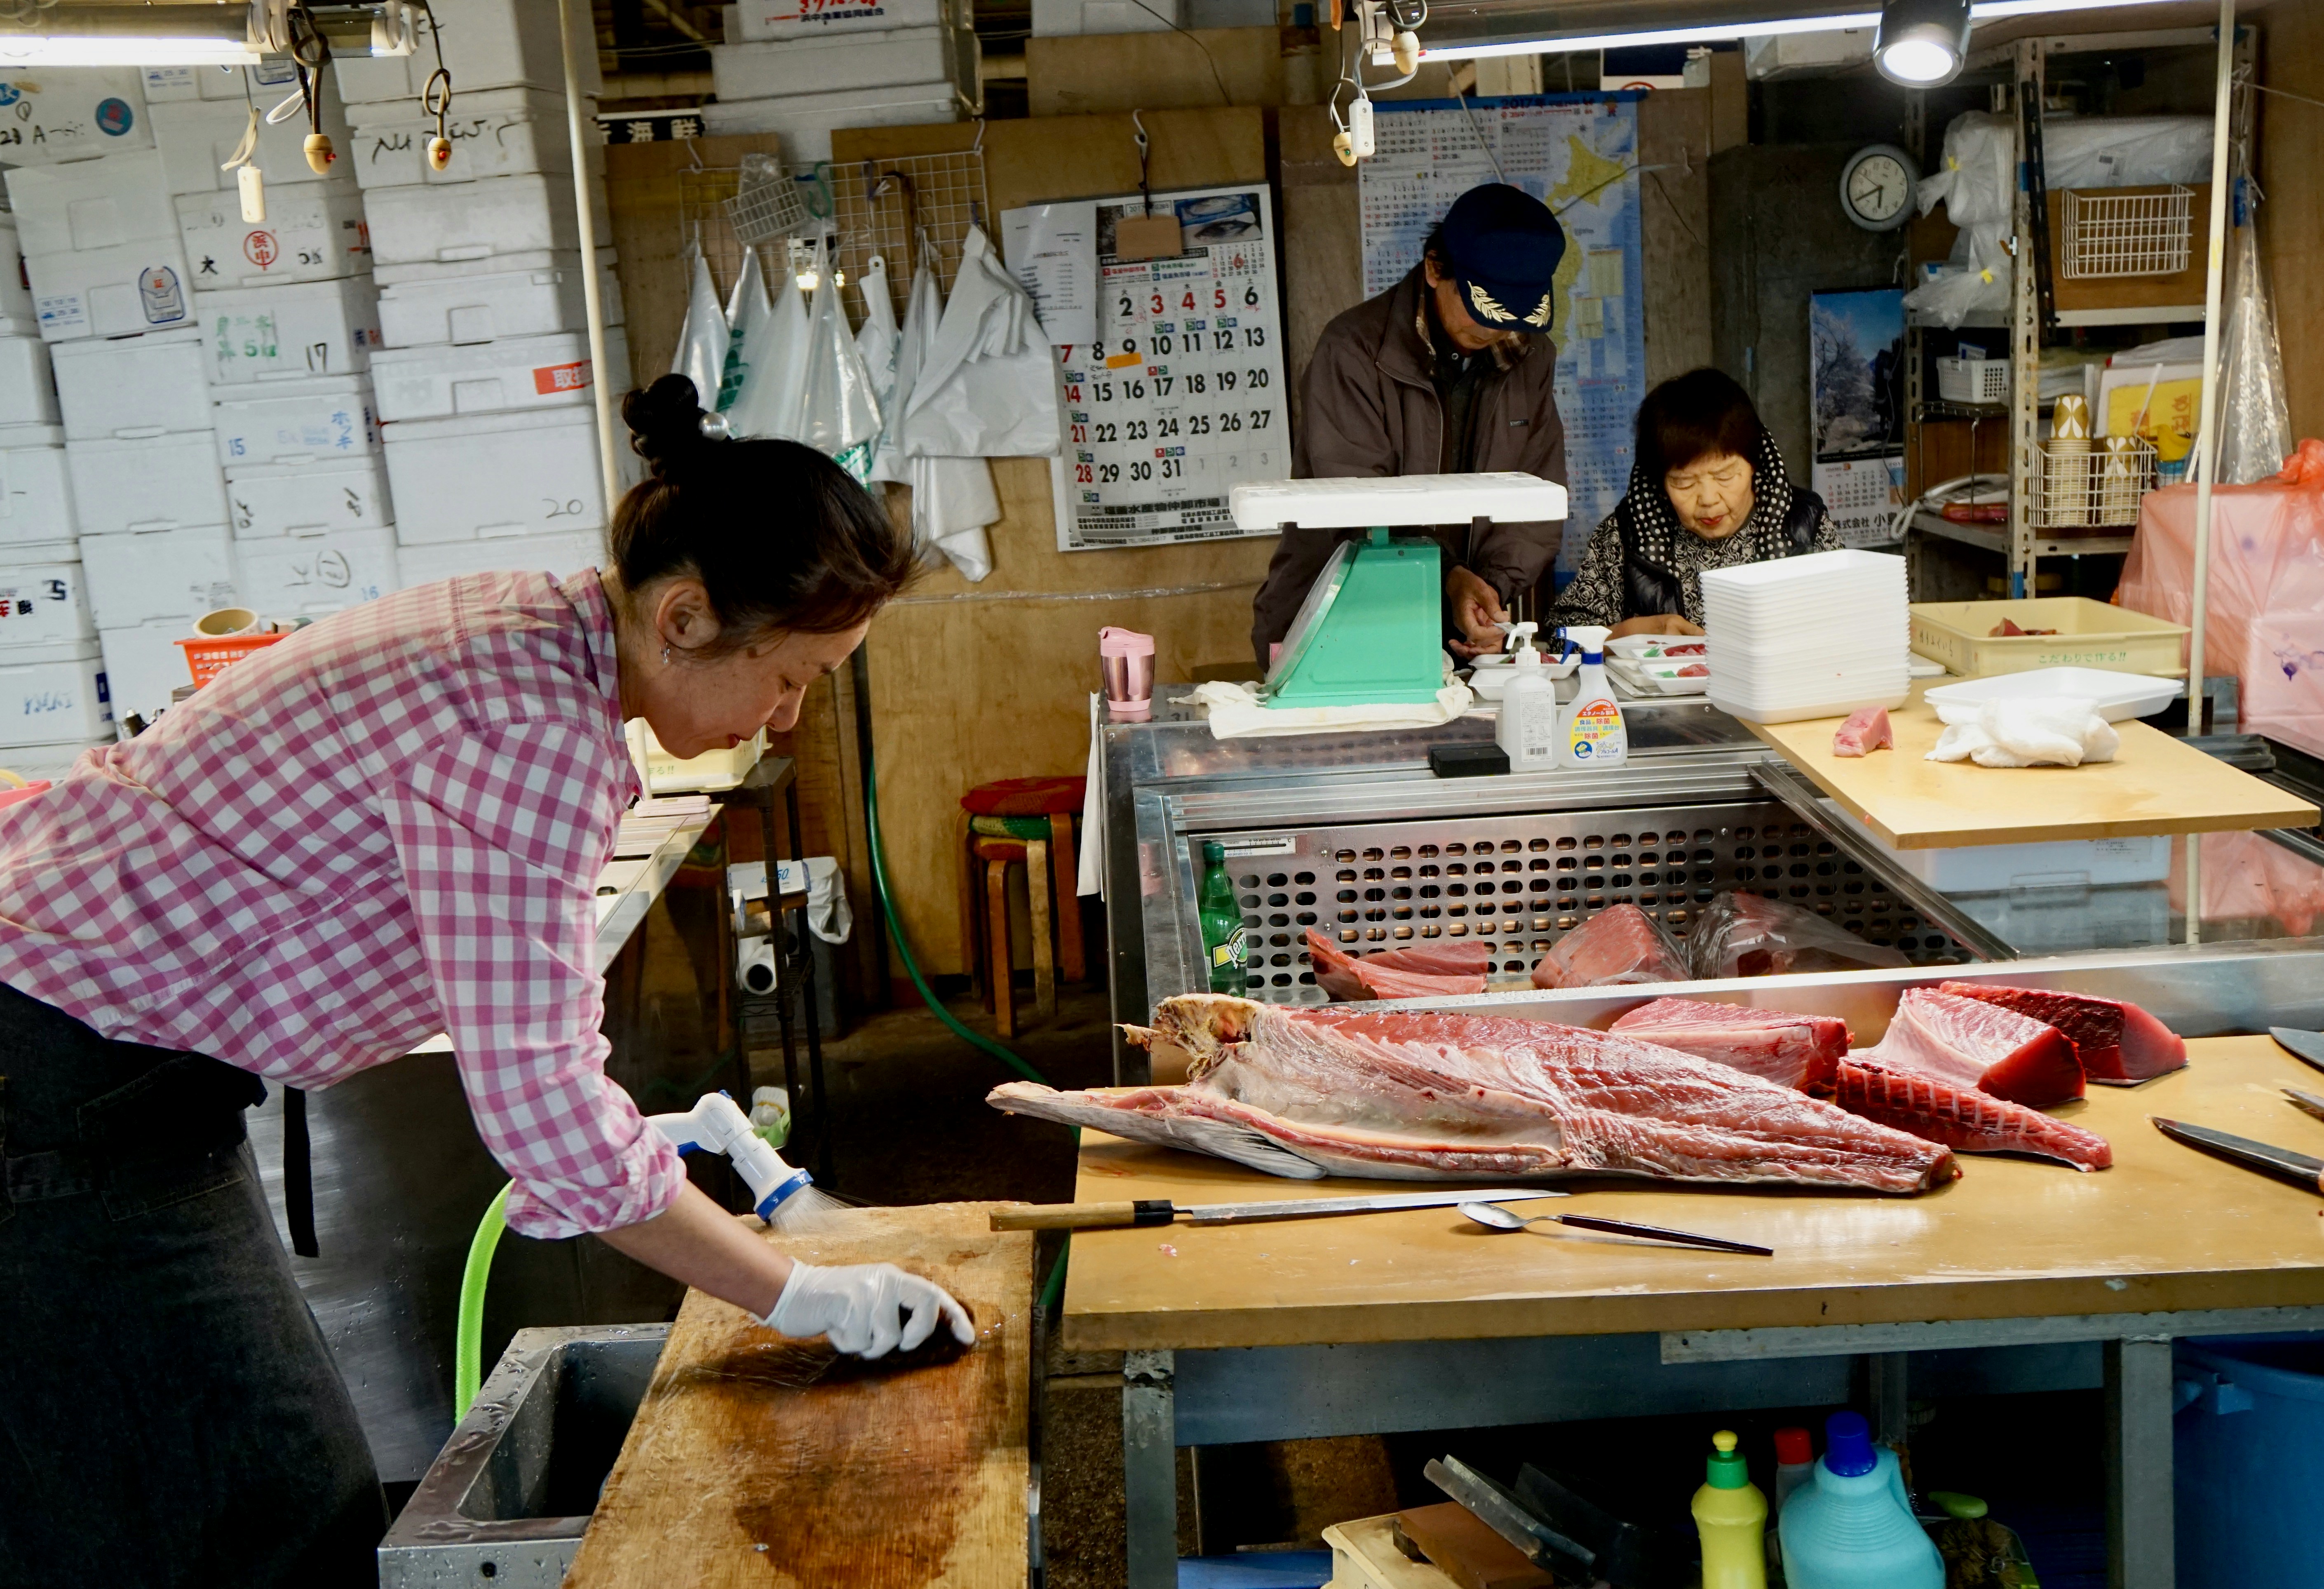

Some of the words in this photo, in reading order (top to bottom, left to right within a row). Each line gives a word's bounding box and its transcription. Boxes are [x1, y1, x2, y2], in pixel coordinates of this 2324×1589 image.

[200, 255, 218, 275] 大
[1119, 297, 1133, 317] 2
[1151, 294, 1164, 314] 3
[1182, 292, 1196, 310] 4
[1214, 289, 1226, 308] 5
[1244, 286, 1258, 306] 6
[306, 342, 327, 372] 17
[1061, 344, 1074, 363] 7
[1092, 341, 1105, 361] 8
[1122, 338, 1136, 353] 9
[1150, 335, 1172, 355] 10
[1182, 333, 1200, 352] 11
[1213, 330, 1234, 350] 12
[1245, 327, 1265, 347] 13
[1064, 383, 1082, 403] 14
[1093, 382, 1113, 402] 15
[1123, 380, 1145, 399] 16
[1154, 377, 1174, 396] 17
[1185, 374, 1206, 393] 18
[1217, 371, 1237, 391] 19
[1247, 368, 1269, 388] 20
[1071, 424, 1087, 443] 21
[1095, 423, 1117, 443] 22
[1126, 420, 1148, 440] 23
[1157, 418, 1179, 437] 24
[1189, 415, 1210, 435] 25
[1220, 413, 1242, 432] 26
[1250, 410, 1271, 429] 27
[228, 438, 245, 456] 15
[1075, 464, 1093, 484] 28
[1099, 464, 1120, 483] 29
[1130, 461, 1152, 481] 30
[1162, 458, 1181, 478] 31
[1229, 455, 1237, 468] 2
[1261, 452, 1269, 465] 3
[542, 498, 583, 519] 20
[2039, 652, 2126, 663] こだわりで作る!!
